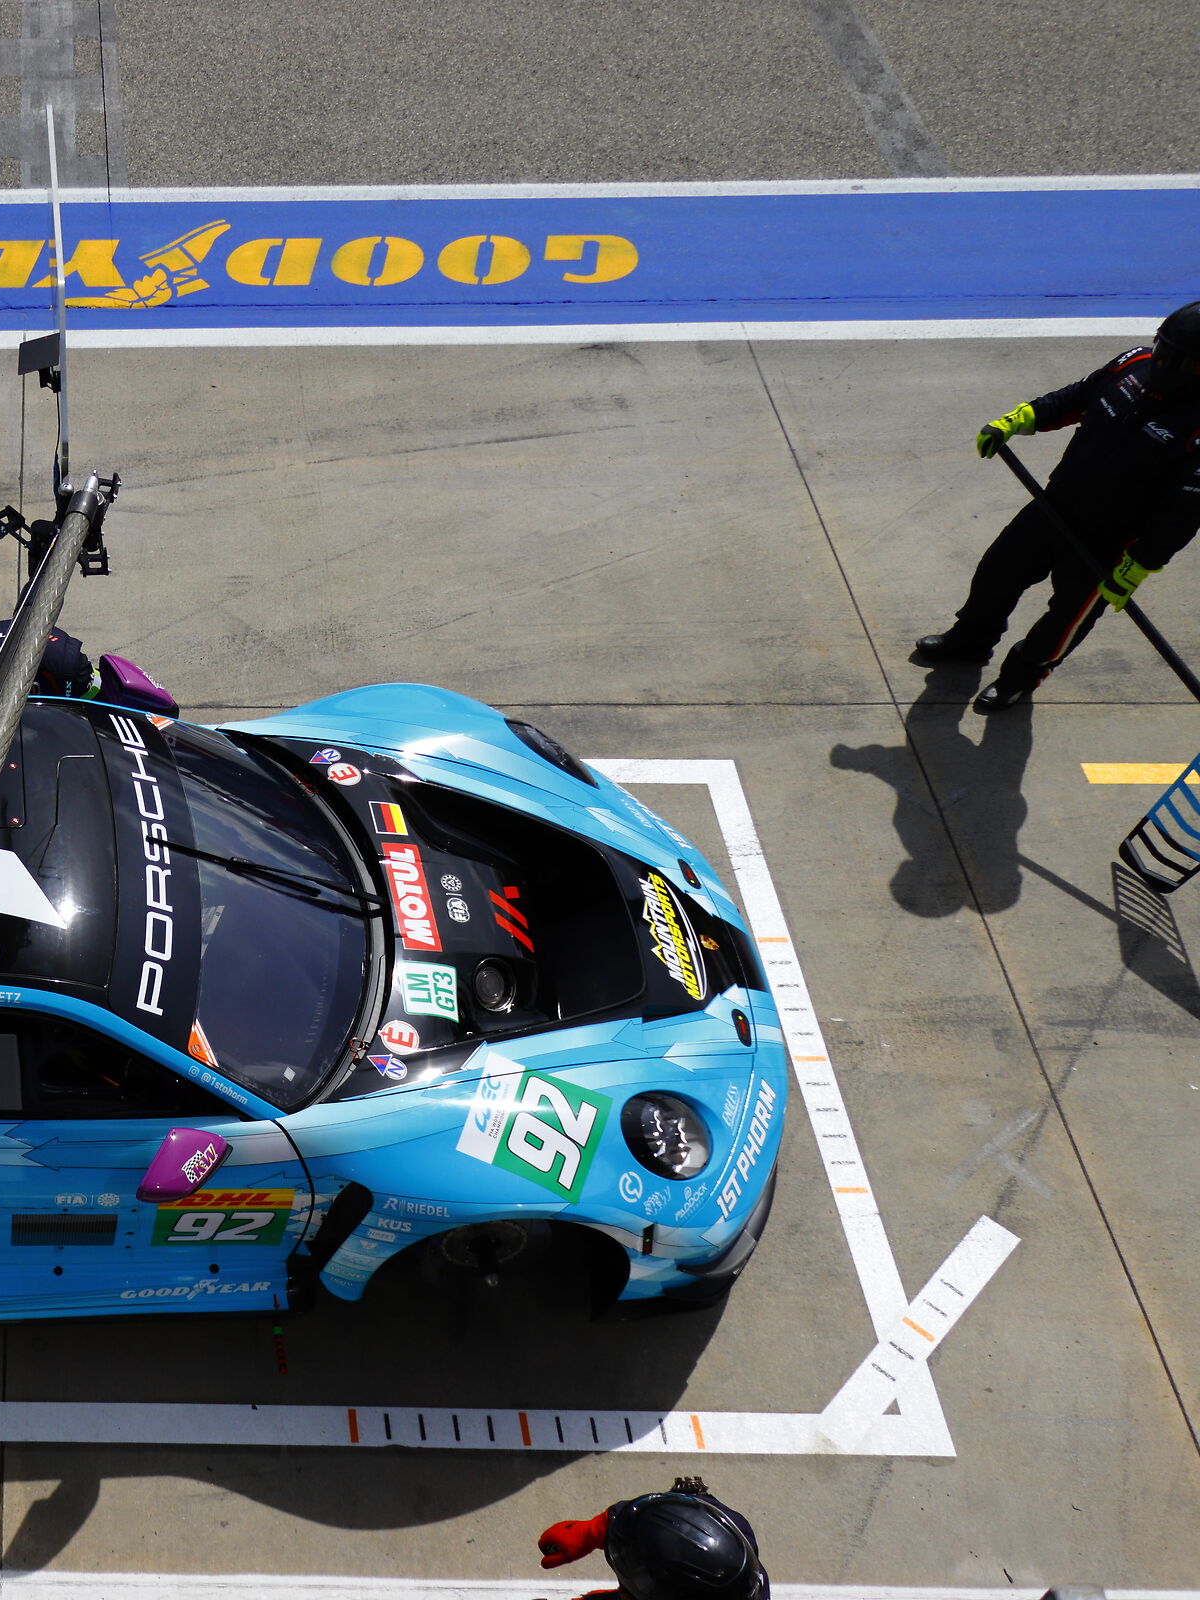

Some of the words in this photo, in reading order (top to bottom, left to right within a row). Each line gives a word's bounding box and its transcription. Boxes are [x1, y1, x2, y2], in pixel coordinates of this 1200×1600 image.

[109, 714, 174, 1016] PORSCHE
[390, 848, 436, 946] MOTUL
[648, 872, 701, 1000] MOTORSPORTS
[406, 973, 433, 1004] LM
[432, 971, 455, 1013] GT3
[200, 1072, 248, 1105] @1stphorm
[506, 1075, 599, 1192] 92
[716, 1168, 742, 1219] 1ST
[736, 1079, 777, 1183] PHORM
[176, 1193, 276, 1207] DHL
[406, 1202, 451, 1218] RIEDEL
[167, 1211, 277, 1241] 92
[119, 1280, 271, 1299] GOODYEAR
